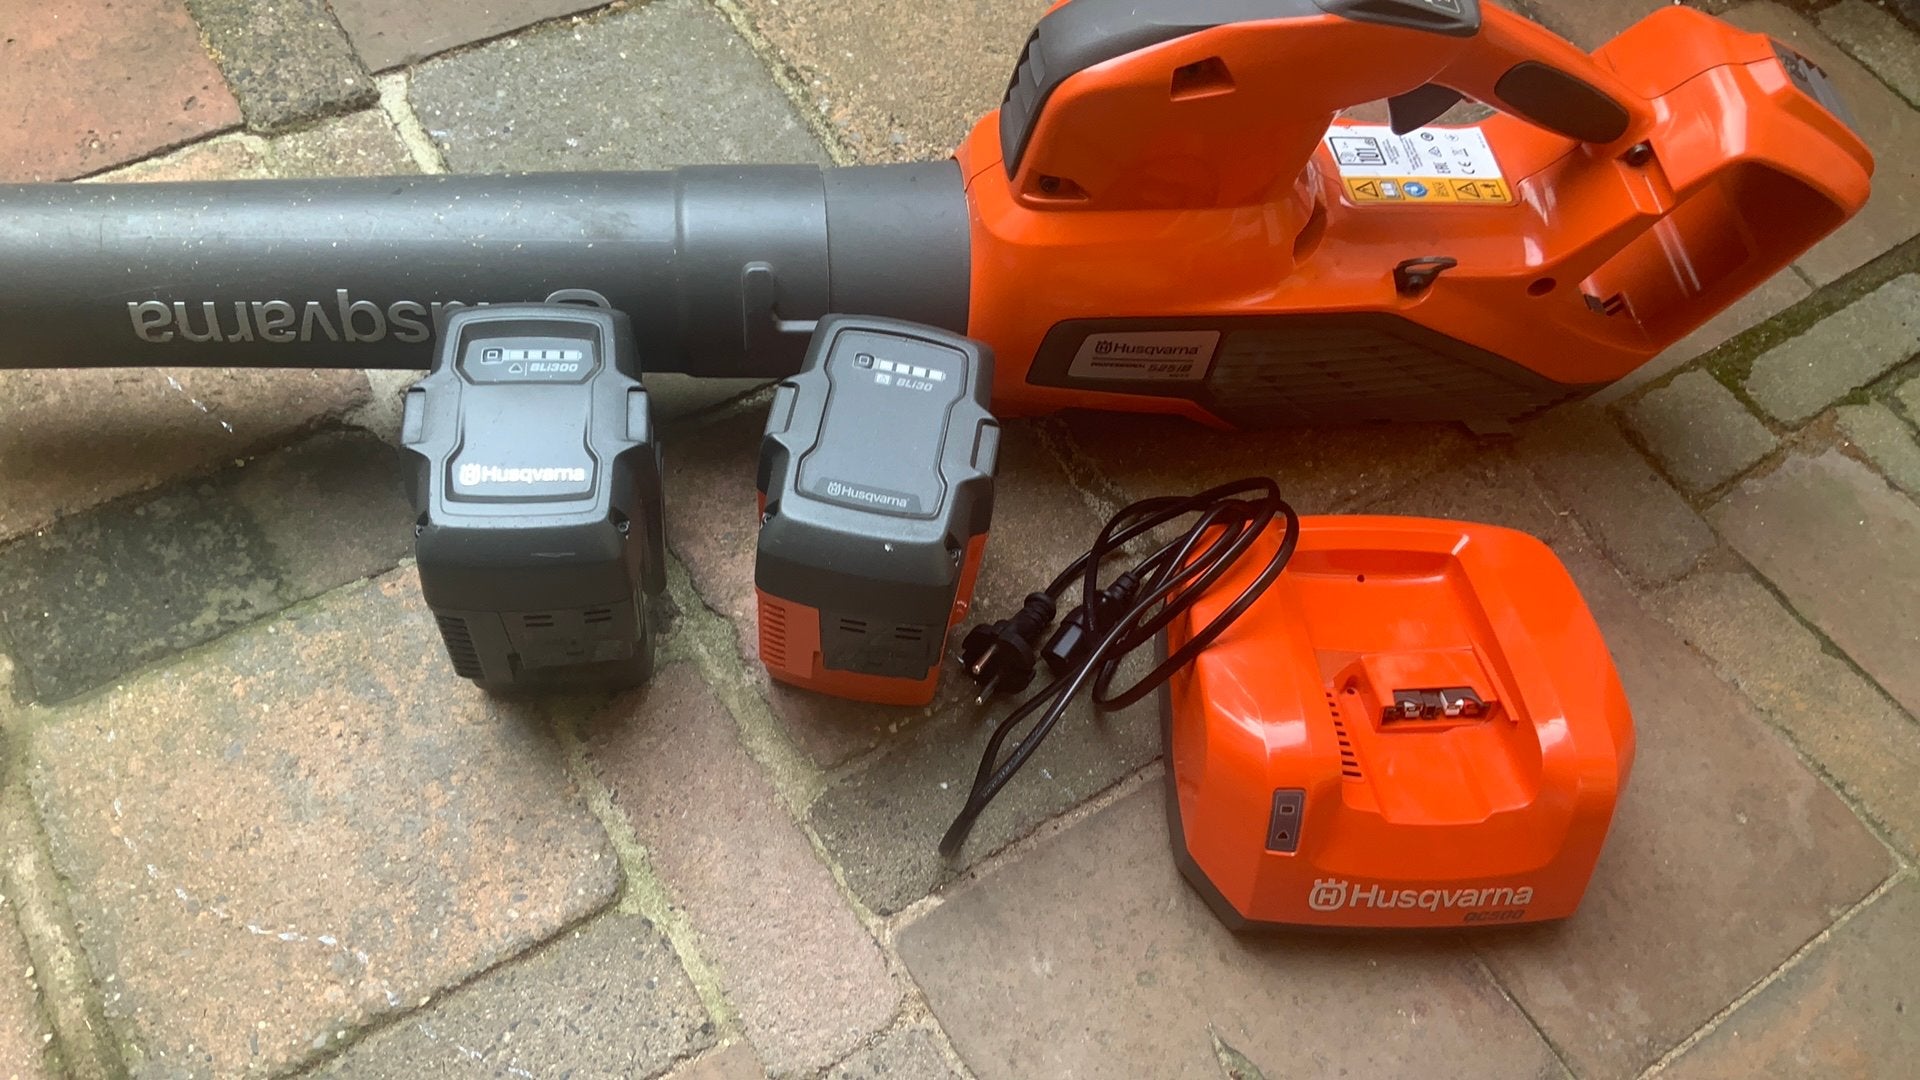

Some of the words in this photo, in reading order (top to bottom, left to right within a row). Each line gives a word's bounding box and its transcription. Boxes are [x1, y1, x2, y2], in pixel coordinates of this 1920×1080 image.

[127, 288, 489, 344] sqvarna
[1113, 343, 1199, 356] Husqvarna
[529, 362, 579, 373] BLi300
[895, 377, 934, 393] BLi30
[481, 465, 586, 484] Husqvarna
[841, 486, 908, 508] Husqvarna
[1349, 884, 1533, 912] Husqvarna
